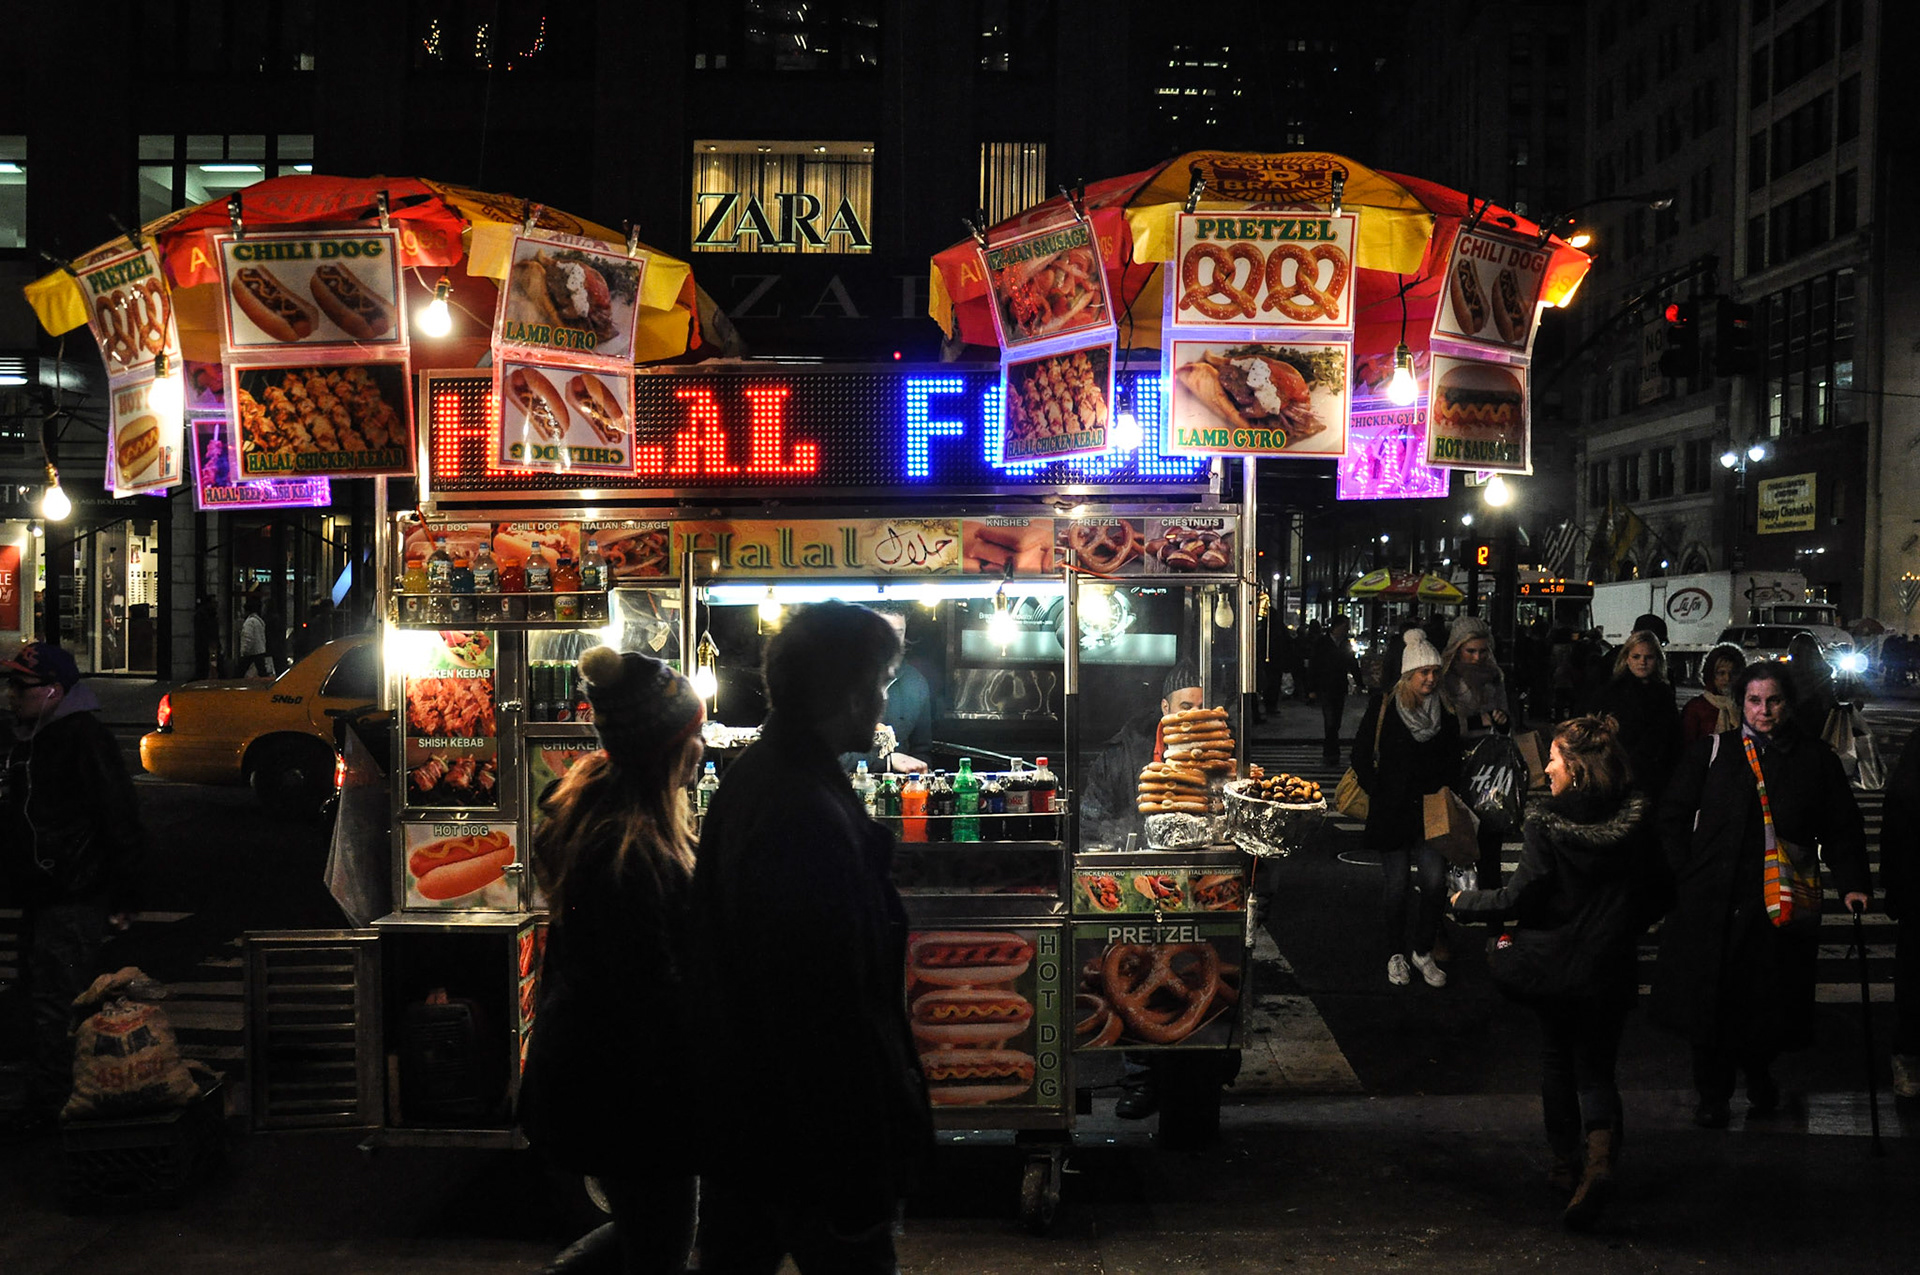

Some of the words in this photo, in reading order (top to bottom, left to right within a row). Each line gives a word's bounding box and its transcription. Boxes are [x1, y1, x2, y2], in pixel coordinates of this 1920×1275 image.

[1223, 180, 1331, 190] BRAND
[693, 192, 872, 247] ZARA
[1195, 217, 1337, 241] PRETZEL
[233, 242, 313, 261] CHILI
[319, 240, 383, 259] DOG
[1034, 227, 1089, 257] SAUSAGE
[1459, 236, 1504, 264] CHILI
[1508, 248, 1545, 273] DOG
[87, 254, 153, 294] PRETZEL
[505, 322, 550, 344] LAMB
[554, 327, 597, 350] GYRO
[1007, 440, 1035, 457] HALAL
[1036, 435, 1072, 455] CHICKEN
[1072, 429, 1104, 449] KEBAB
[1178, 428, 1228, 448] LAMB
[1233, 428, 1286, 448] GYRO
[1435, 437, 1462, 459] HOT
[1464, 440, 1520, 462] SAUSAGE
[249, 452, 293, 472] HALAL
[295, 450, 355, 471] CHICKEN
[205, 487, 238, 503] HALAL
[239, 485, 263, 502] BEEF
[447, 523, 468, 531] DOG
[510, 522, 536, 531] CHILI
[538, 523, 559, 531] DOG
[582, 521, 619, 530] ITALIAN
[620, 521, 668, 530] SAUSAGE
[985, 518, 1029, 527] KNISHES
[1077, 518, 1121, 527] PRETZEL
[1161, 518, 1220, 527] CHESTNUTS
[679, 526, 867, 570] Halal
[456, 669, 490, 679] KEBAB
[418, 738, 448, 748] SHISH
[450, 738, 484, 748] KEBAB
[1469, 764, 1513, 796] H&M
[434, 825, 458, 836] HOT
[462, 825, 489, 836] DOG
[1108, 926, 1206, 944] PRETZEL
[1039, 935, 1058, 1009] HOT
[1039, 1025, 1058, 1098] DOG
